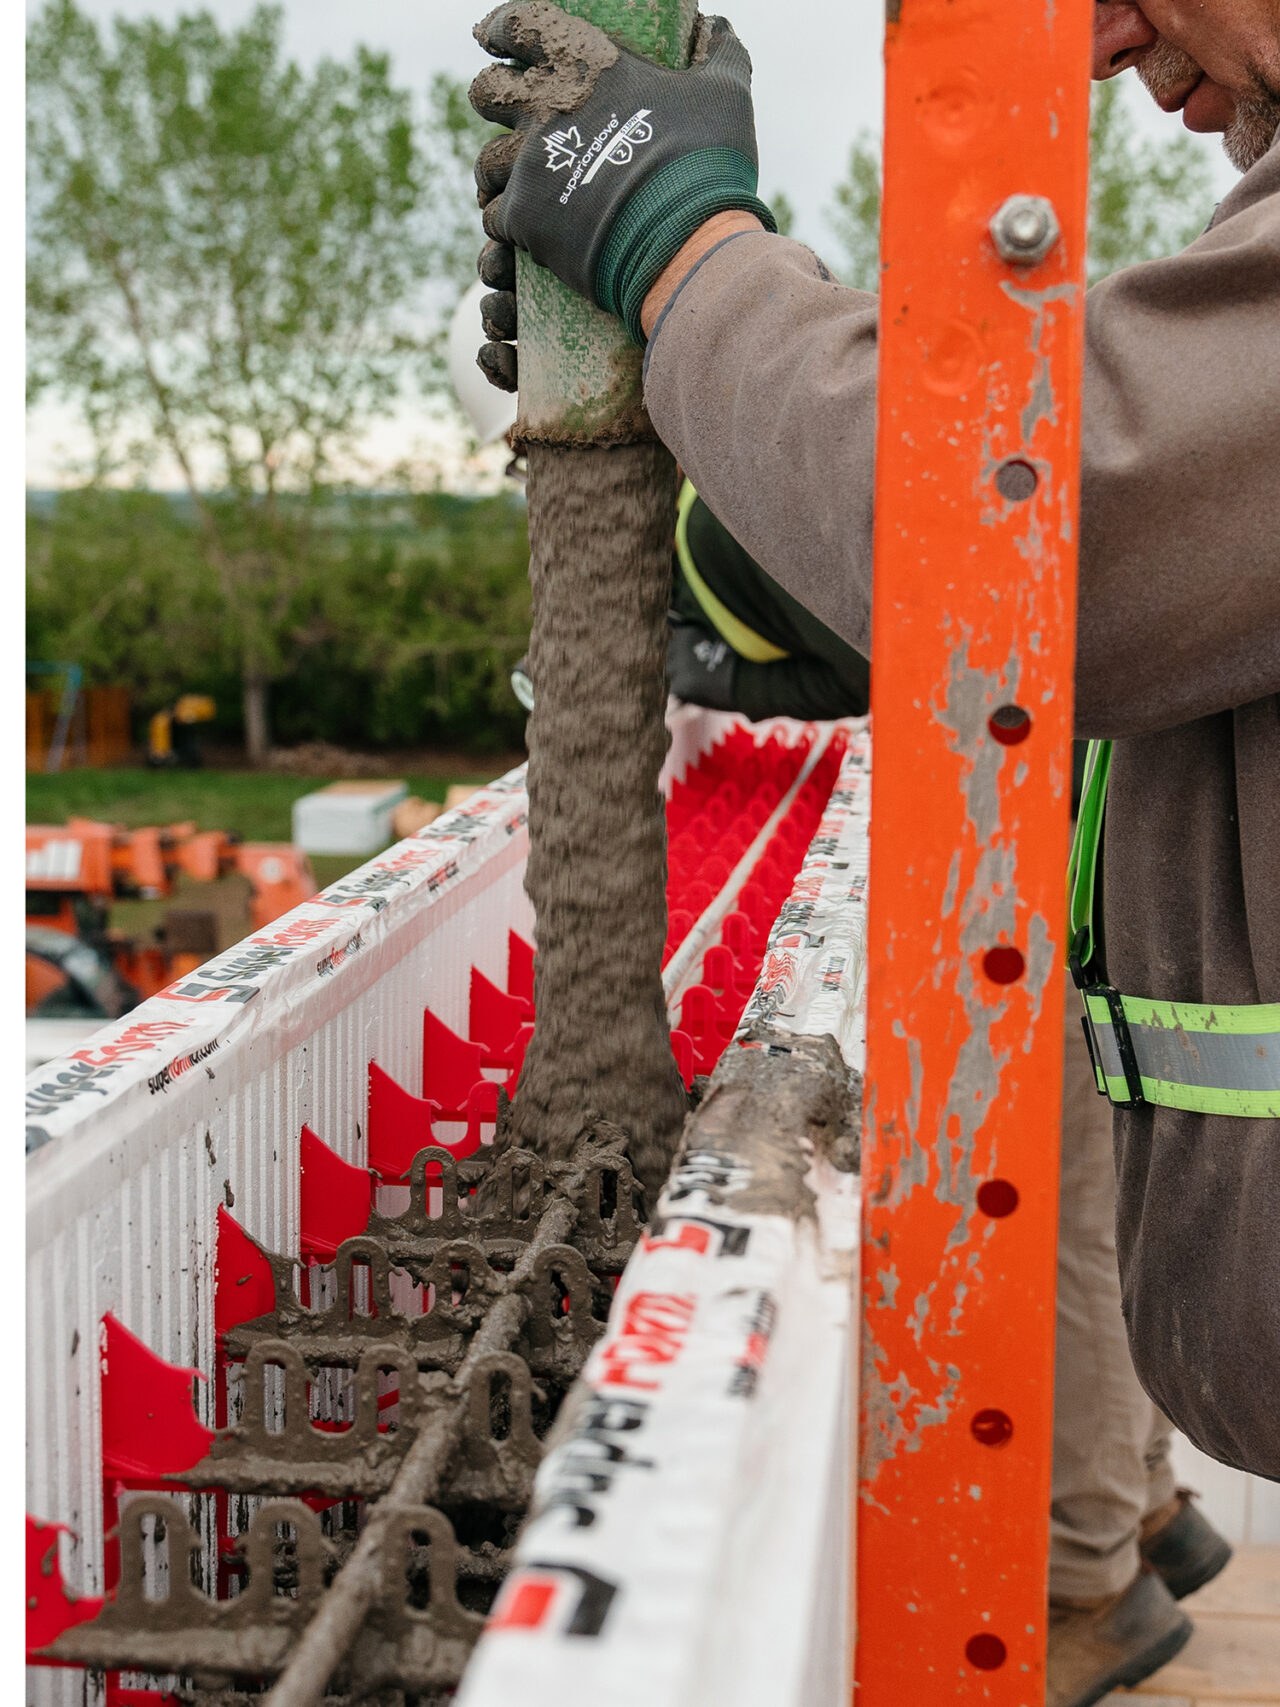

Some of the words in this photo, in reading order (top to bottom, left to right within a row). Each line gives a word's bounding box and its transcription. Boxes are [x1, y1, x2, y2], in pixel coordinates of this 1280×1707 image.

[635, 128, 646, 138] 3
[616, 148, 627, 159] 2
[559, 119, 619, 205] superiorglove
